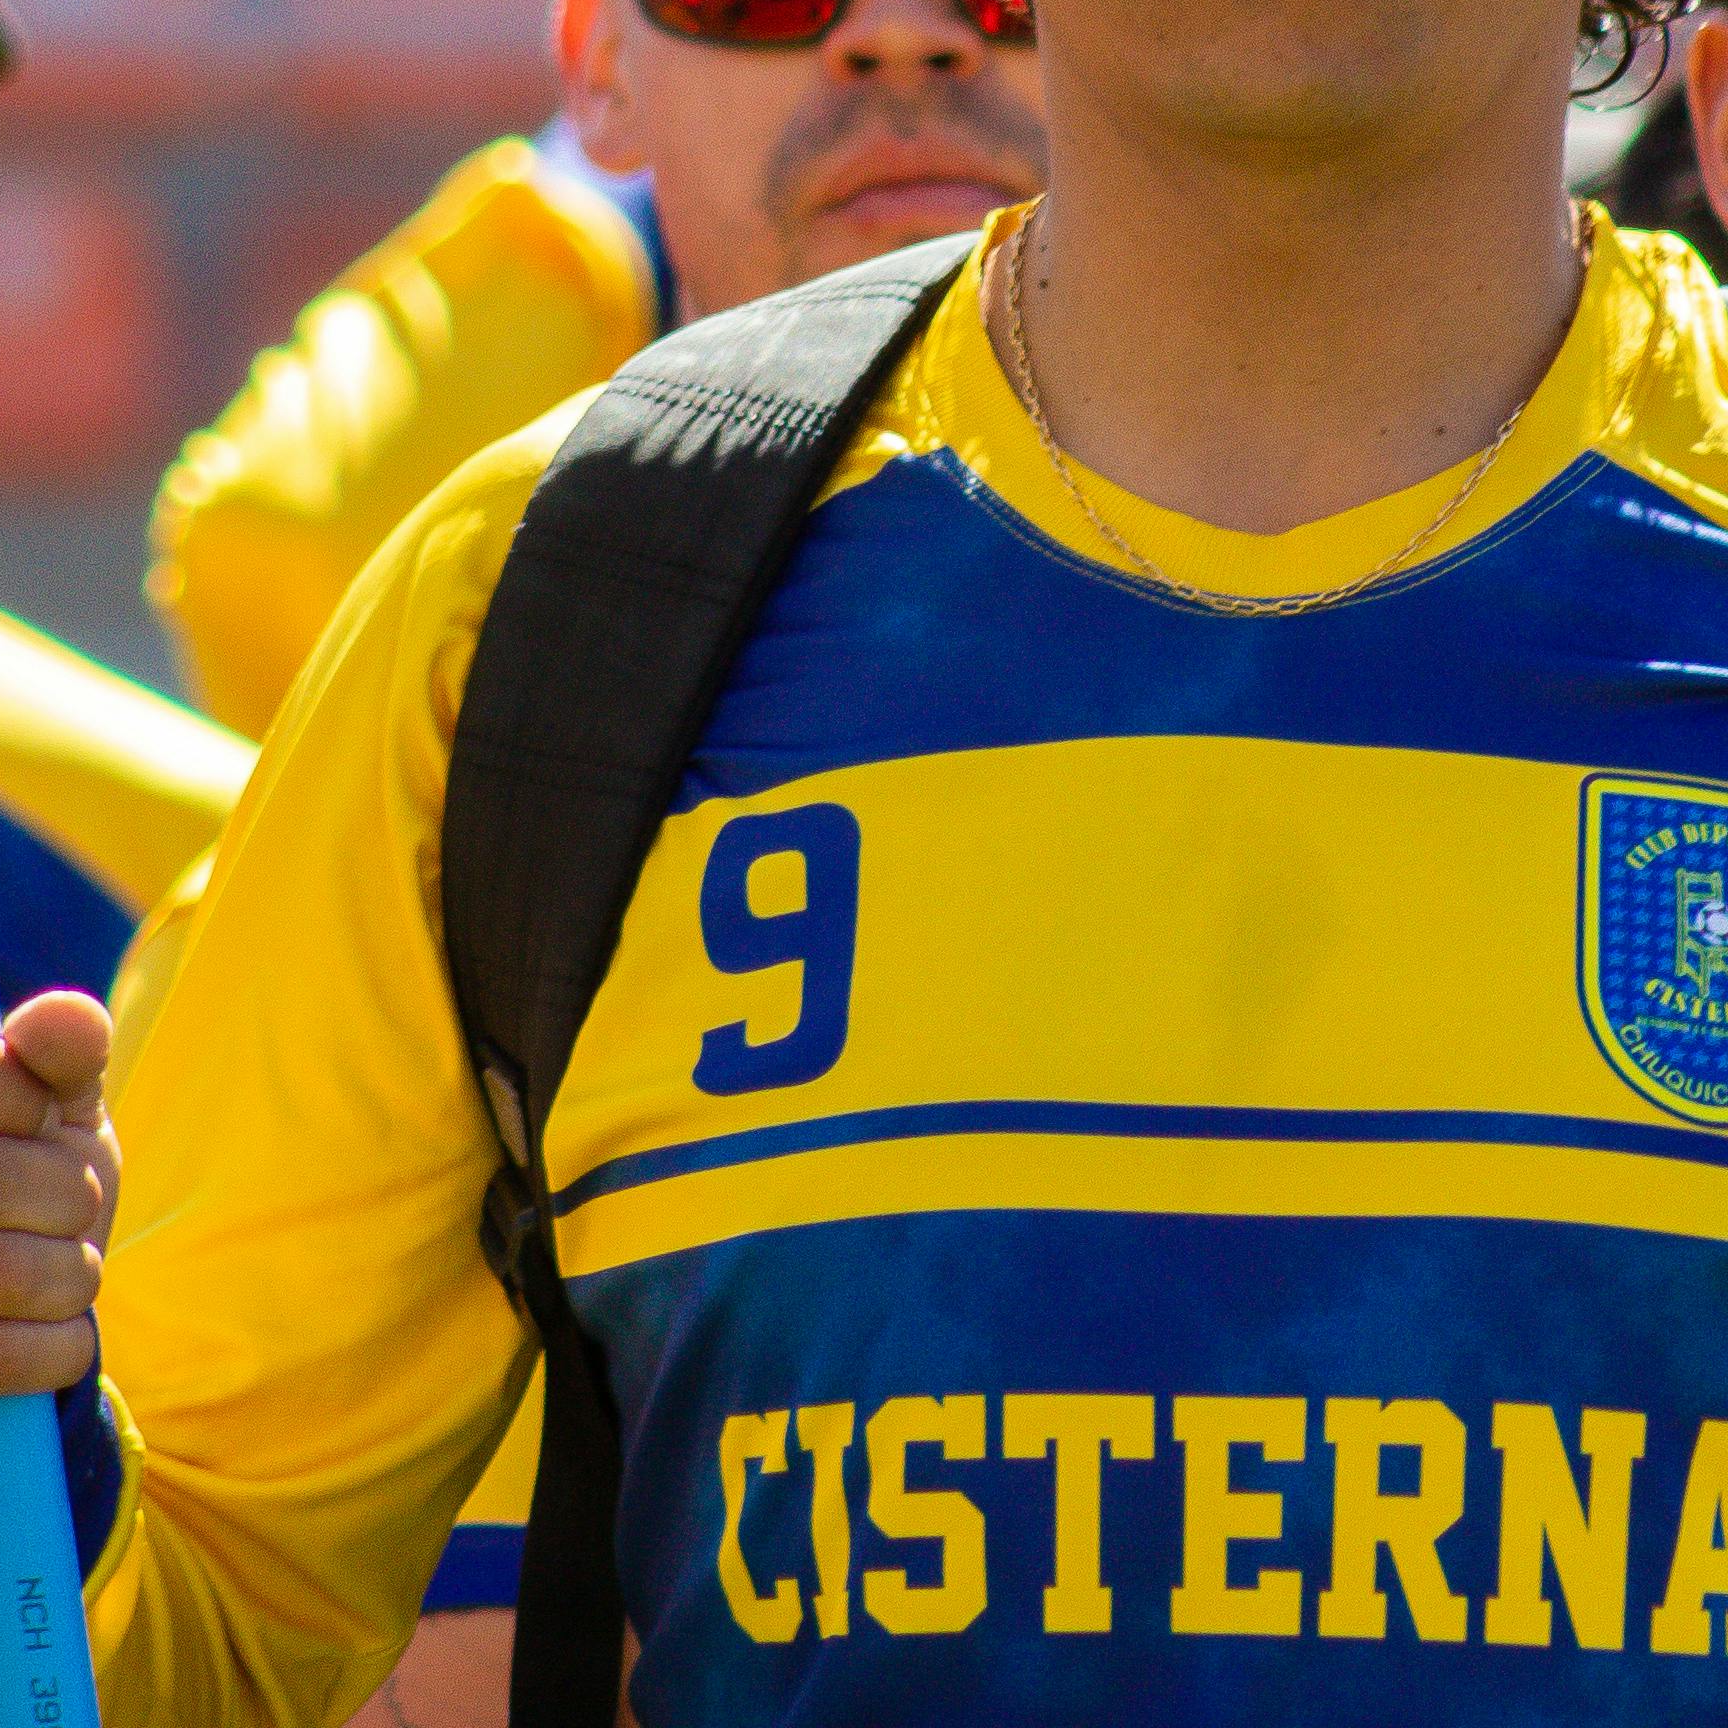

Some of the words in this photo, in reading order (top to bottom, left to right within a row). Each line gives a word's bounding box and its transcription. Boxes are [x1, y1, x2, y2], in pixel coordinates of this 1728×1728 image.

[1625, 828, 1678, 871] CLUB
[690, 801, 862, 1099] 9
[16, 1575, 52, 1651] NCH
